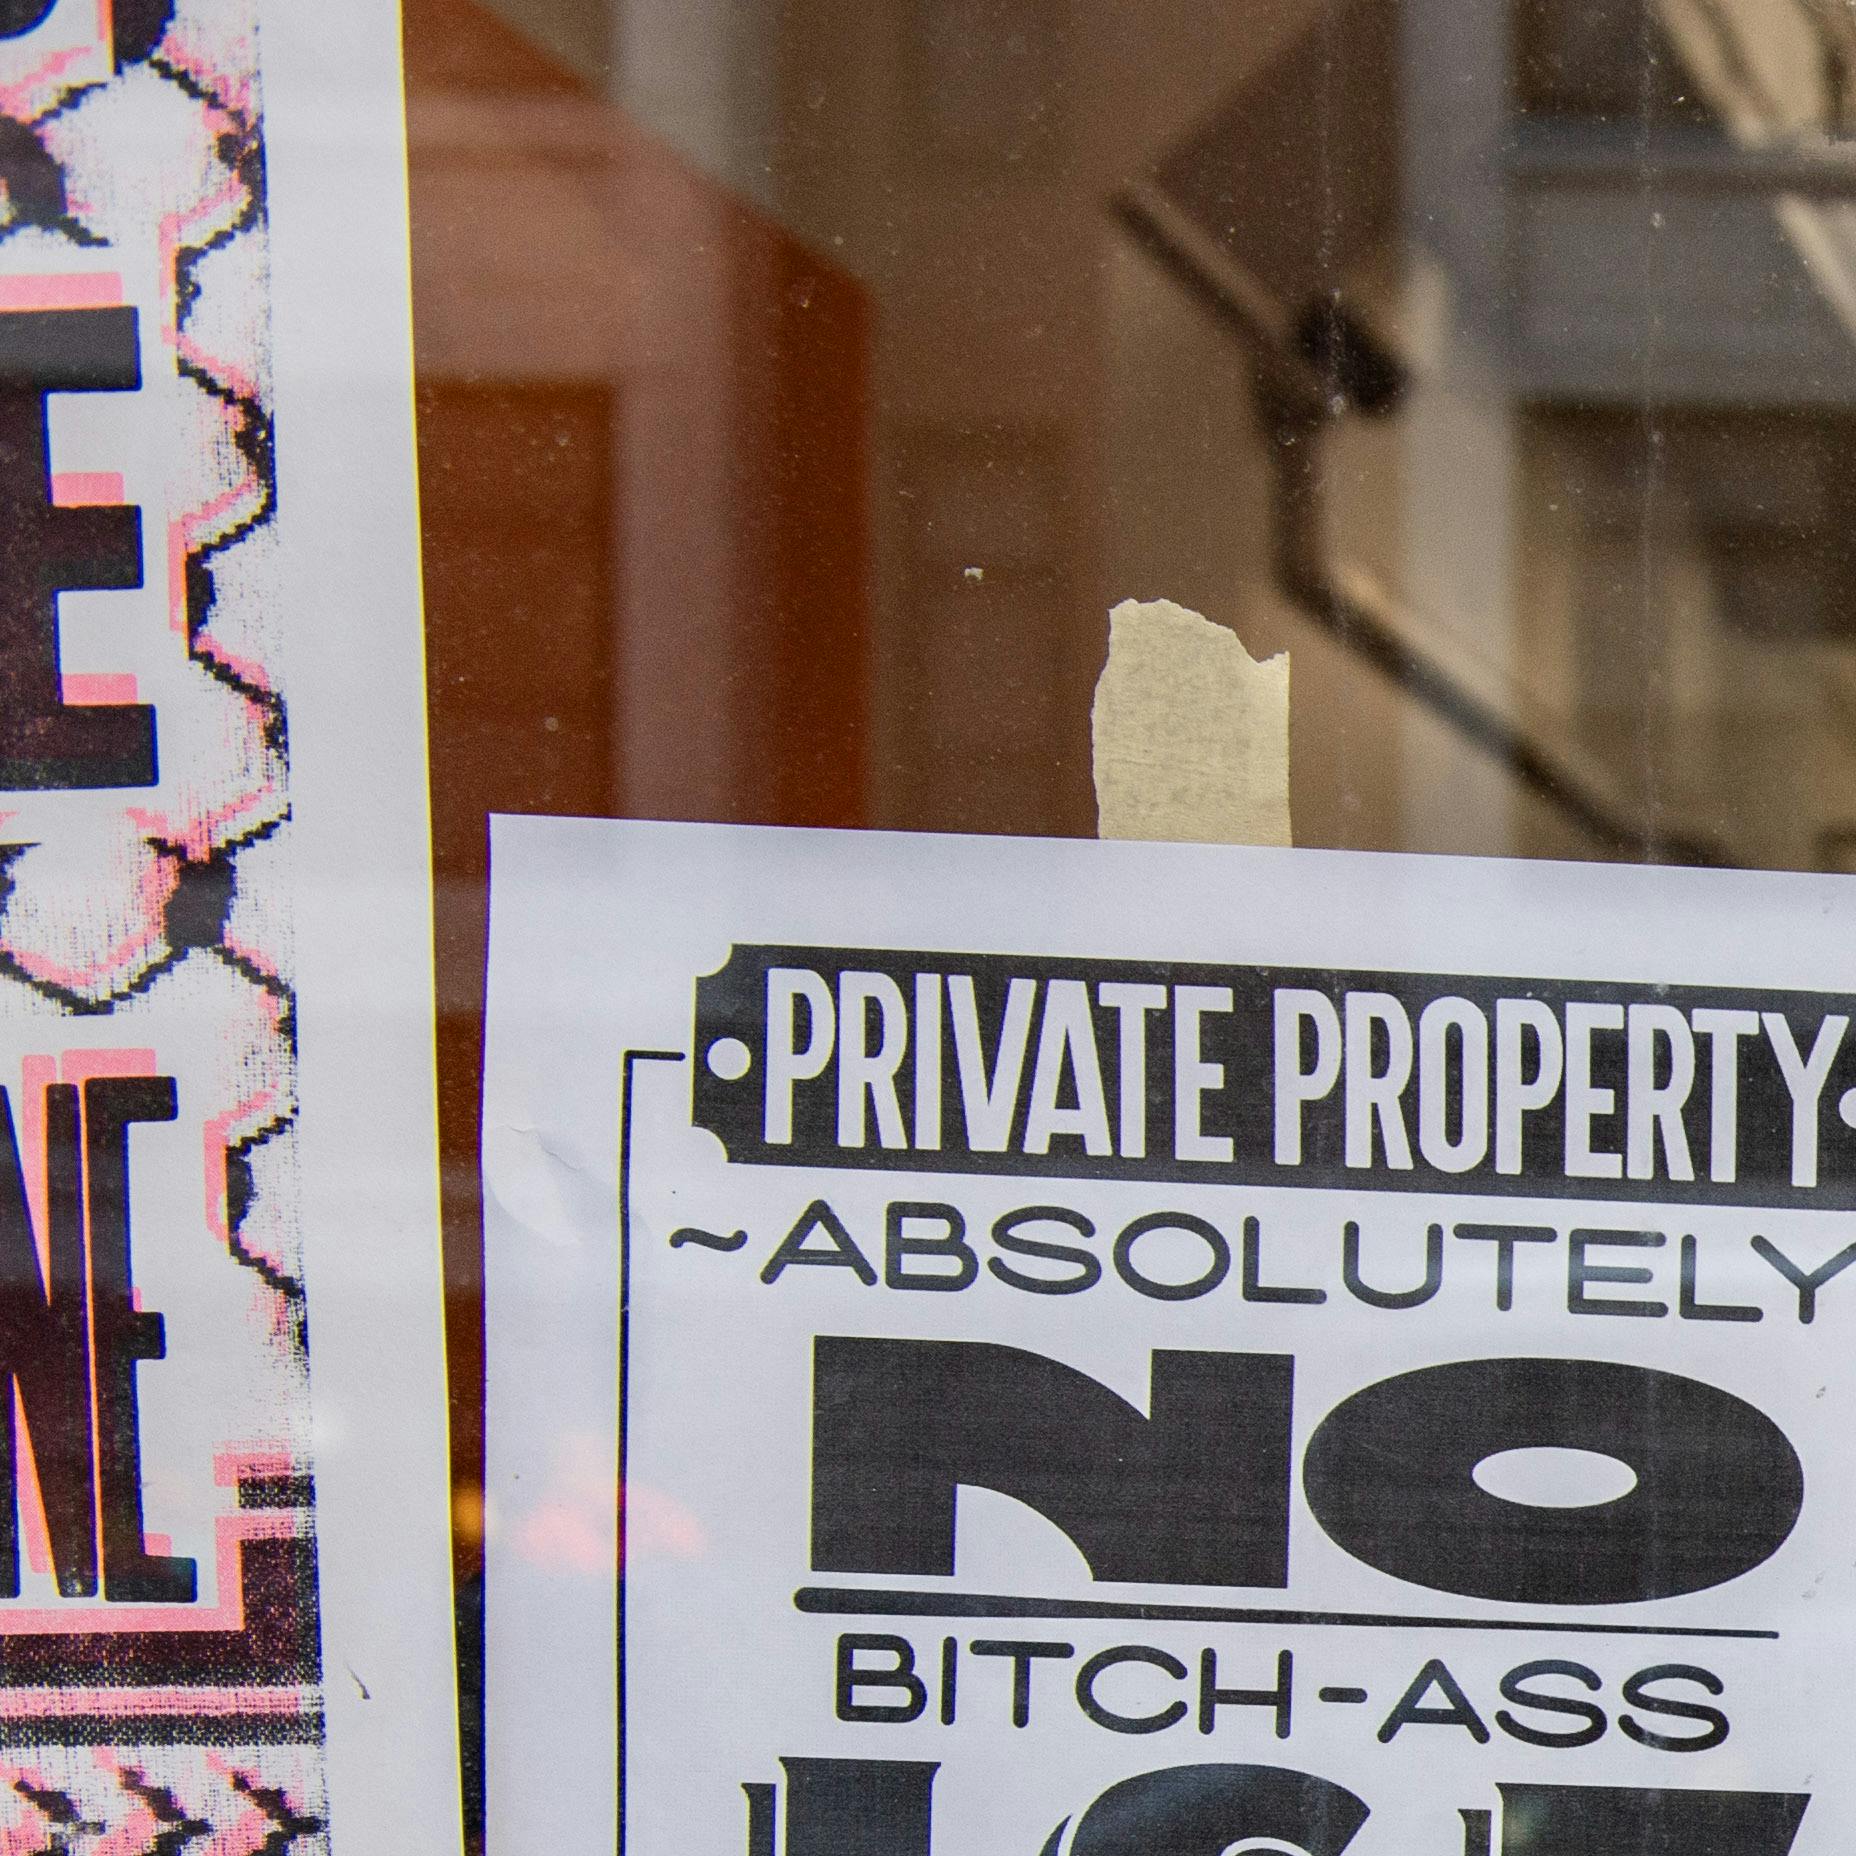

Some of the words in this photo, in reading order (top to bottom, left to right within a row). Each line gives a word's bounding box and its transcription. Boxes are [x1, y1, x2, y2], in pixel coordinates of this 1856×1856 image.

[765, 968, 1233, 1162] PRIVATE
[1274, 989, 1850, 1187] PROPERTY
[811, 1335, 1804, 1605] NO
[836, 1633, 1729, 1752] BITCH-ASS
